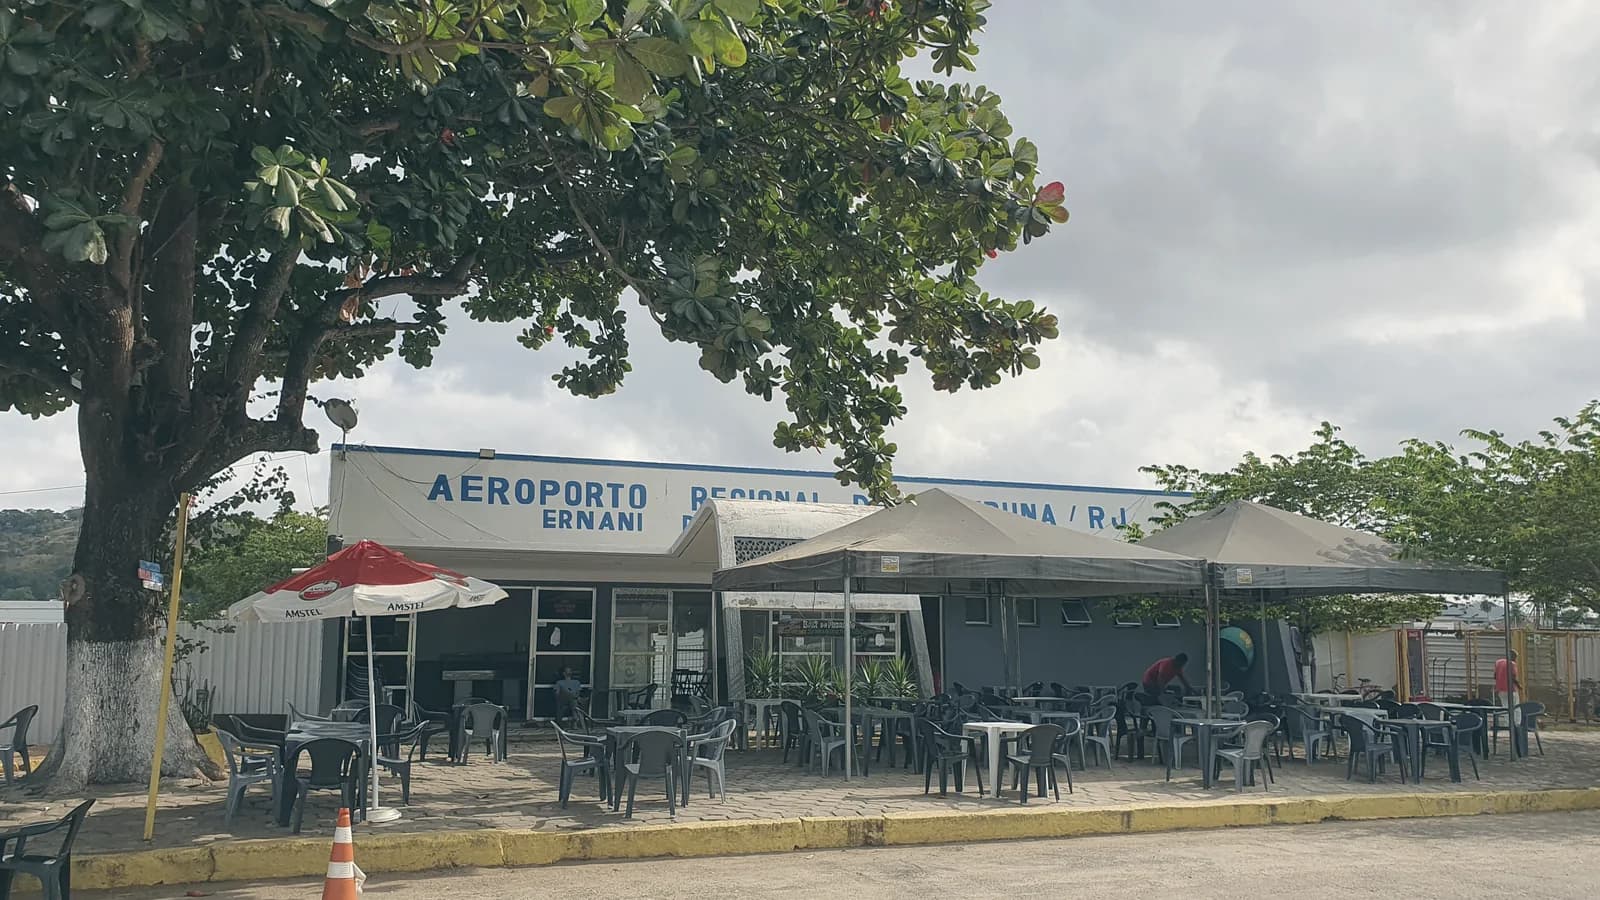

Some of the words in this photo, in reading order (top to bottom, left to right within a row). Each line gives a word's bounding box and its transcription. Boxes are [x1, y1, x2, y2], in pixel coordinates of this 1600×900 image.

[428, 474, 647, 509] AEROPORTO
[543, 509, 643, 531] ERNANI
[285, 608, 323, 618] AMSTEL
